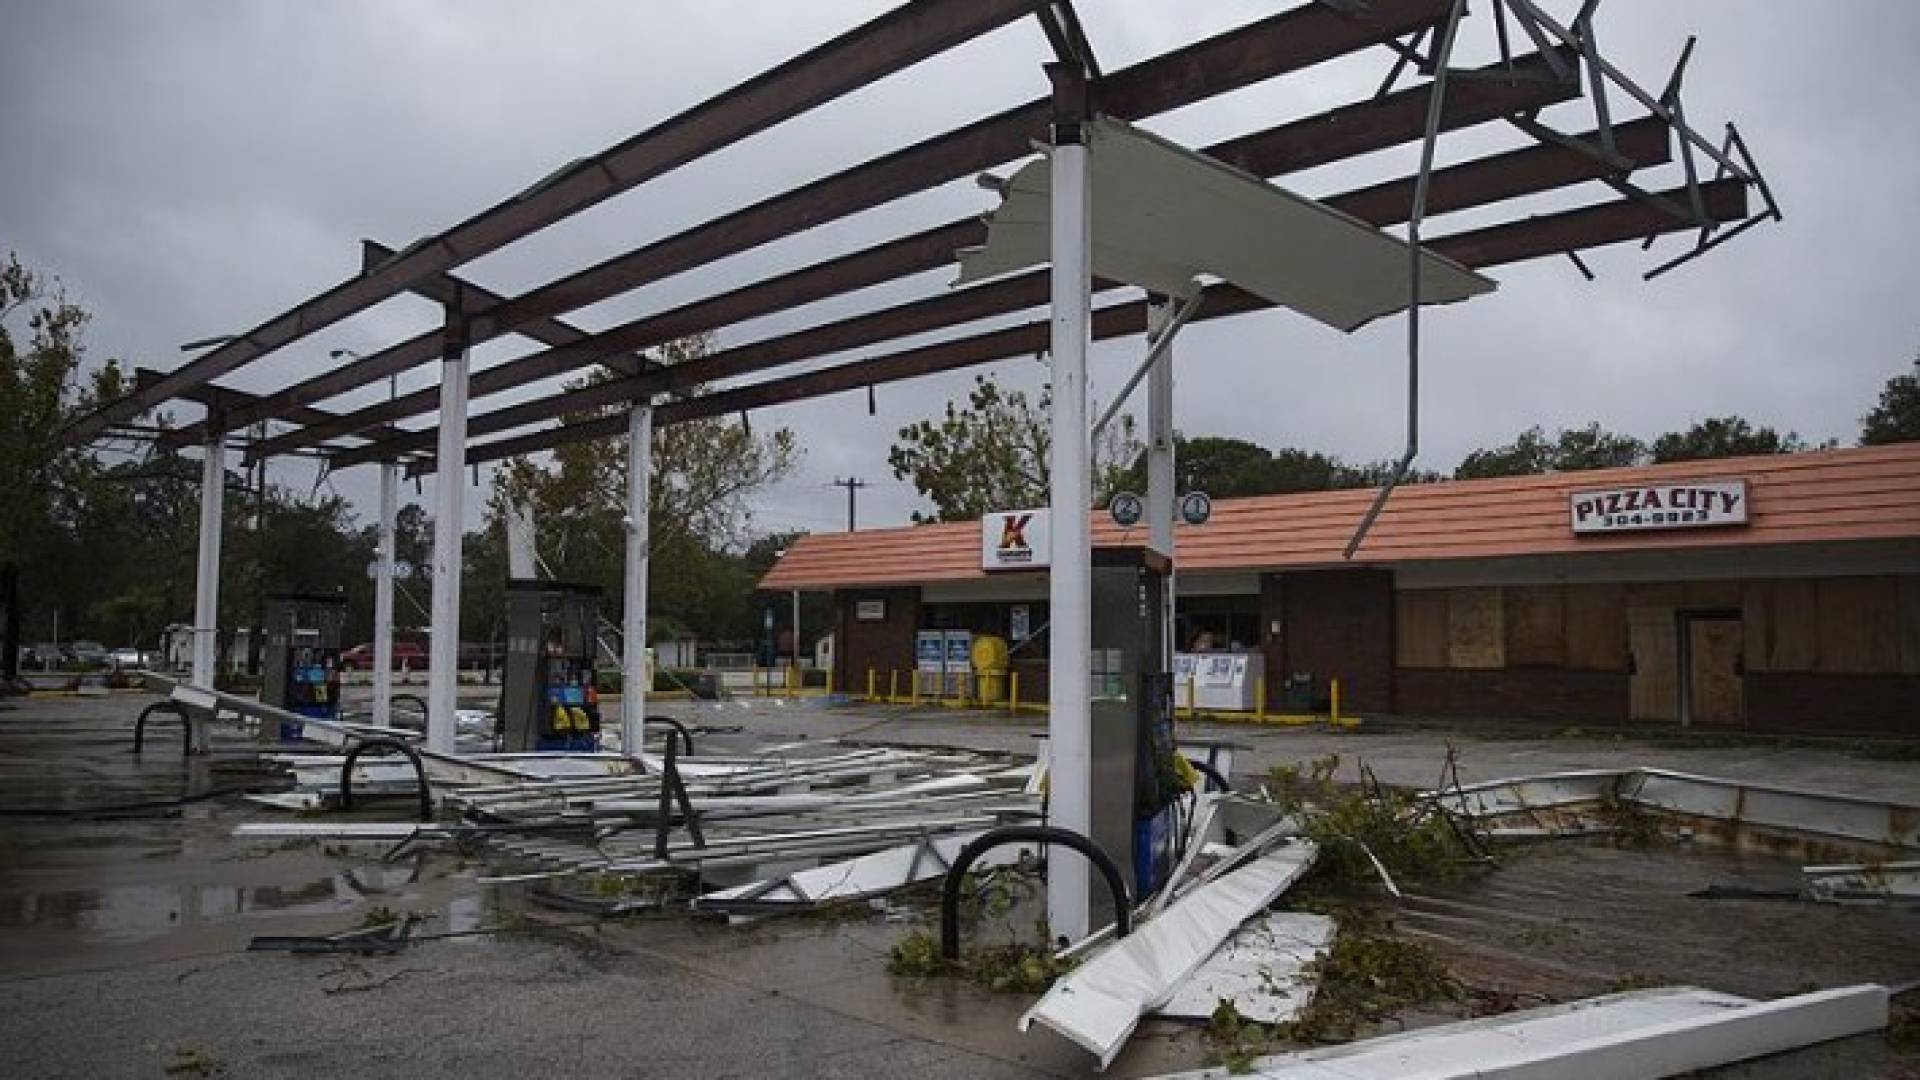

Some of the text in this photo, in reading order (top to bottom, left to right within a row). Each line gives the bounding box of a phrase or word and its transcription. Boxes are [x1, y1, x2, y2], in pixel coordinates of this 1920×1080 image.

[1575, 488, 1740, 521] PIZZA CITY
[998, 515, 1033, 549] K
